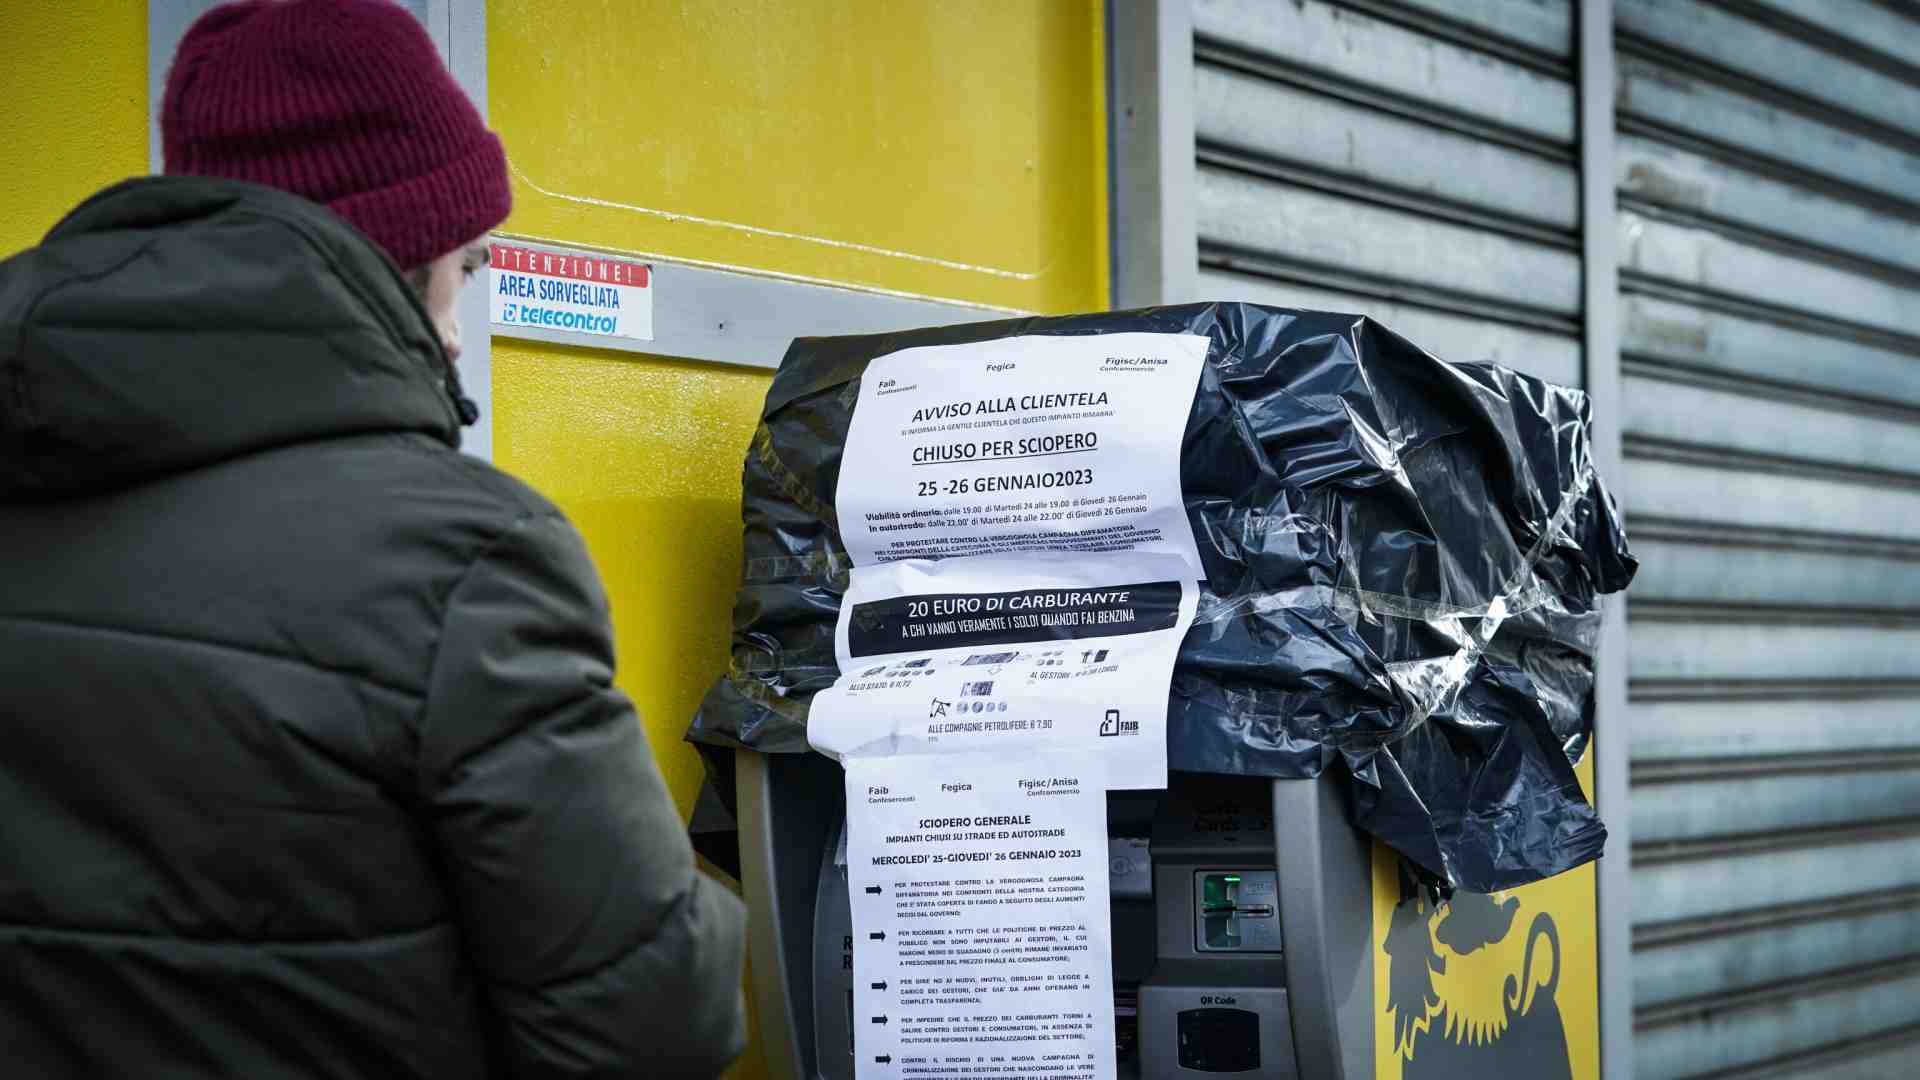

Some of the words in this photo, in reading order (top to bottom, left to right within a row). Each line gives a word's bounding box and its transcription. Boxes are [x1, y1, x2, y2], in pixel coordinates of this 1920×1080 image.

[489, 250, 632, 283] TTENZIONE!
[499, 274, 535, 299] AREA
[540, 279, 620, 309] SORVEGLIATA
[520, 304, 617, 333] telecontrol
[986, 362, 1016, 372] Fegica
[1105, 357, 1168, 366] Figisc/Anisa
[878, 380, 896, 389] Faib
[912, 402, 972, 423] AVVISO
[976, 396, 1016, 414] ALLA
[1020, 392, 1109, 410] CLIENTELA
[947, 422, 972, 430] GENTILE
[974, 420, 1008, 428] CLIENTELA
[1022, 416, 1047, 424] QUESTO
[1048, 413, 1080, 422] IMPIANTO
[912, 442, 976, 463] CHIUSO
[982, 440, 1014, 458] PER
[1018, 432, 1098, 455] SCIOPERO
[918, 481, 937, 497] 25
[942, 478, 968, 494] -26
[974, 468, 1094, 493] GENNAIO2023
[902, 508, 942, 519] ordinaria:
[944, 507, 960, 516] dalle
[1034, 502, 1047, 510] alle
[1118, 494, 1148, 502] Gennaio
[928, 520, 945, 528] dalle
[972, 516, 978, 525] di
[1012, 514, 1022, 522] 24
[1024, 512, 1038, 521] alle
[1067, 510, 1074, 519] di
[1104, 508, 1114, 516] 26
[1115, 504, 1148, 514] Gennaio
[908, 602, 928, 618] 20
[934, 598, 980, 616] EURO
[986, 596, 1002, 611] DI
[1008, 591, 1130, 610] CARBURANTE
[902, 625, 908, 639] A
[910, 624, 925, 638] CHI
[926, 622, 956, 636] VANNO
[956, 618, 1006, 634] VERAMENTE
[1008, 618, 1012, 630] I
[1014, 616, 1038, 630] SOLDI
[1042, 613, 1078, 627] QUANDO
[1082, 611, 1095, 624] FAI
[1098, 608, 1135, 623] BENZINA
[928, 724, 943, 734] ALLE
[944, 722, 982, 733] COMPAGNIE
[984, 720, 1029, 732] PETROLIFERE:
[1120, 720, 1140, 731] FAIB
[868, 786, 889, 796] Faib
[941, 782, 972, 794] Fegica
[1018, 777, 1079, 790] Figisc/Anisa
[919, 817, 972, 830] SCIOPERO
[974, 815, 1032, 828] GENERALE
[886, 834, 923, 844] IMPIANTI
[924, 833, 952, 843] CHIUSI
[953, 832, 963, 842] SU
[965, 831, 997, 841] STRADE
[998, 830, 1010, 839] ED
[1012, 828, 1066, 838] AUTOSTRADE
[872, 853, 930, 866] MERCOLEDI'
[994, 852, 1007, 862] 26
[1009, 850, 1056, 861] GENNAIO
[1058, 849, 1082, 859] 2023
[910, 880, 950, 888] PROTESTARE
[1200, 996, 1212, 1005] QR
[1214, 996, 1236, 1004] Code
